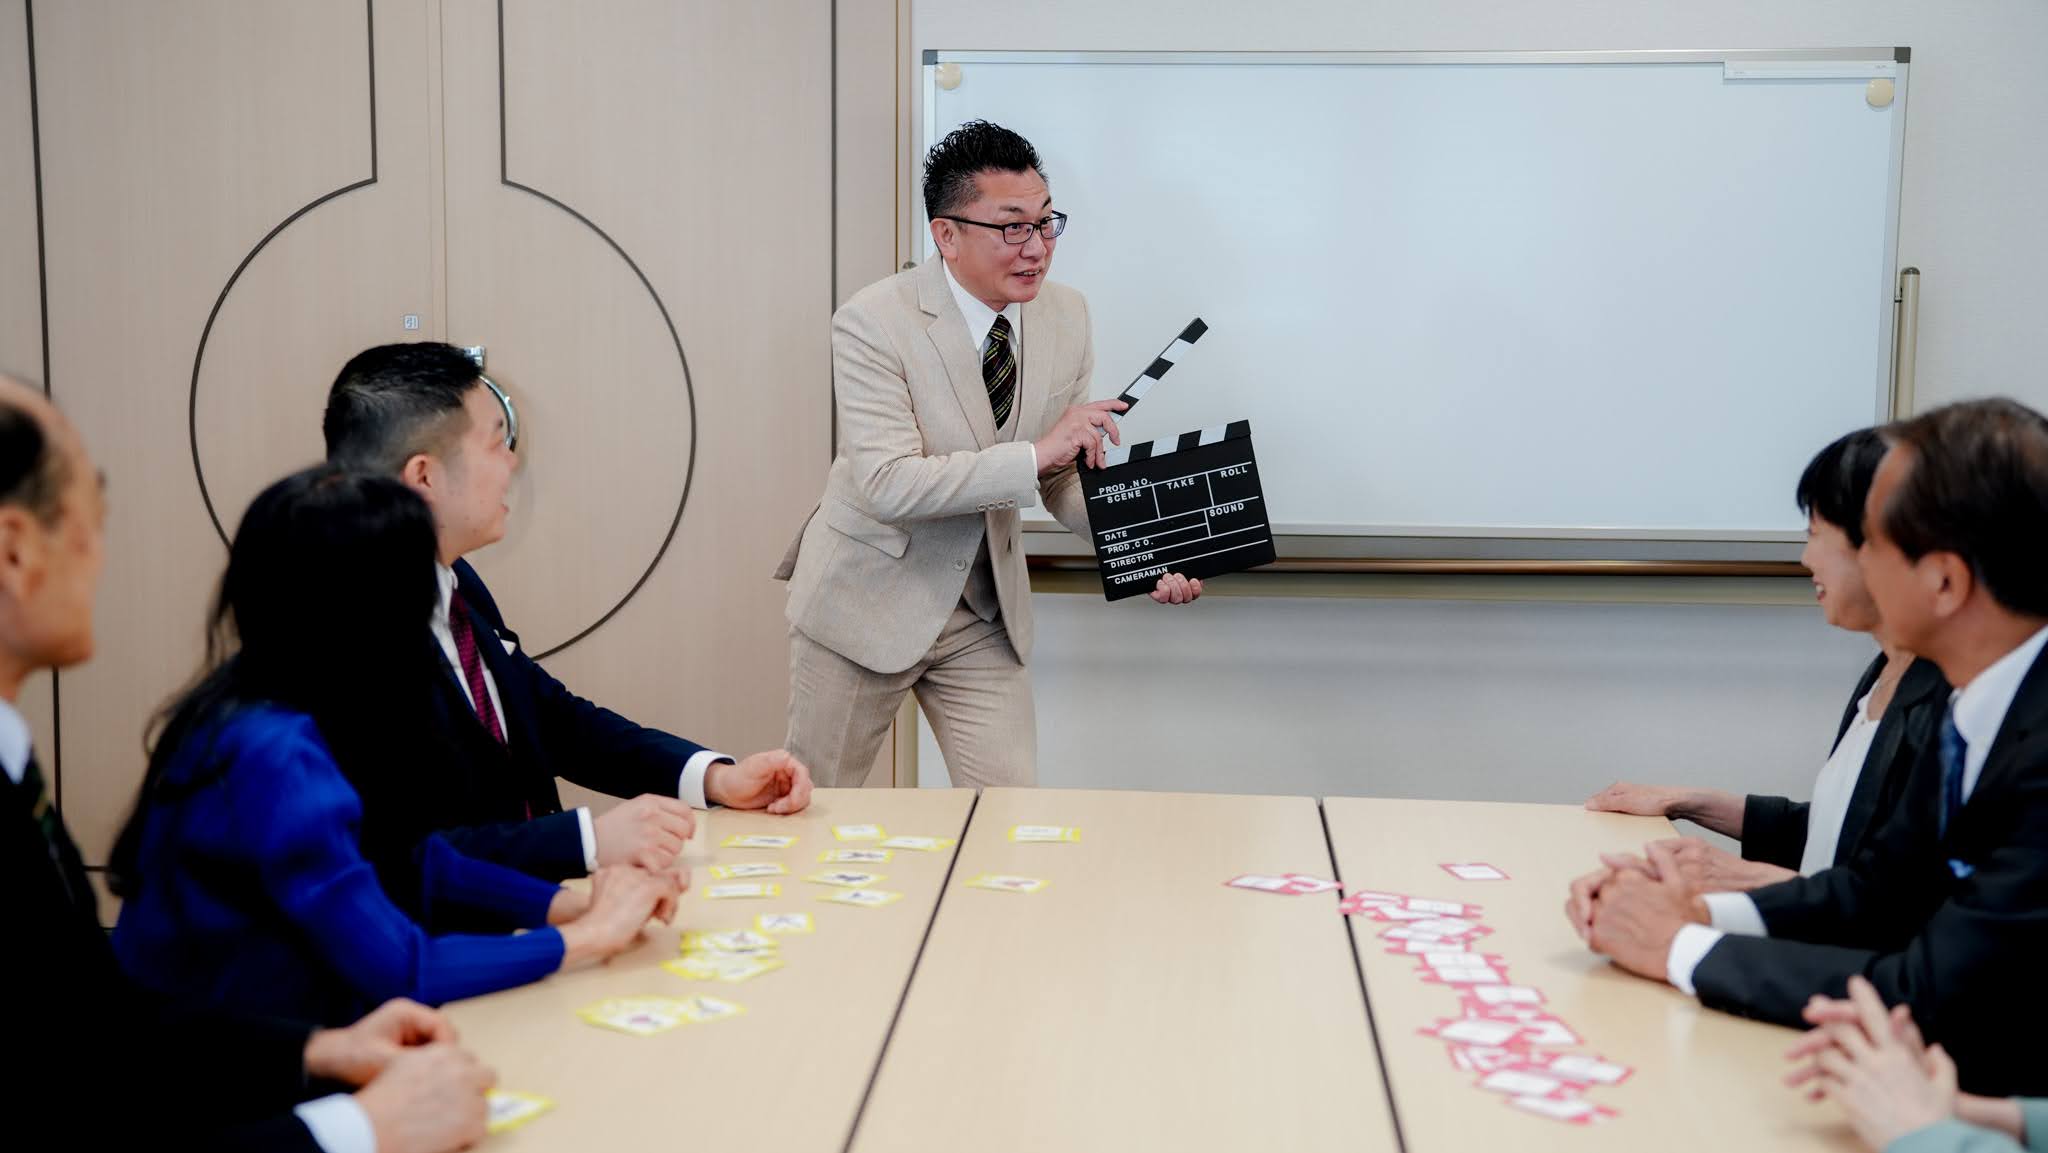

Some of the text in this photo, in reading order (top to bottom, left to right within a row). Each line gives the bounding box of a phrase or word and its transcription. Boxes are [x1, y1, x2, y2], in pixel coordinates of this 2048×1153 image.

[1220, 466, 1248, 479] ROLL
[1166, 477, 1195, 490] TAKE
[1107, 490, 1142, 504] SCENE
[1209, 502, 1245, 517] SOUND
[1104, 530, 1128, 541] DATE
[1110, 553, 1154, 569] DIRECTOR
[1114, 566, 1169, 585] CAMERAMAN
